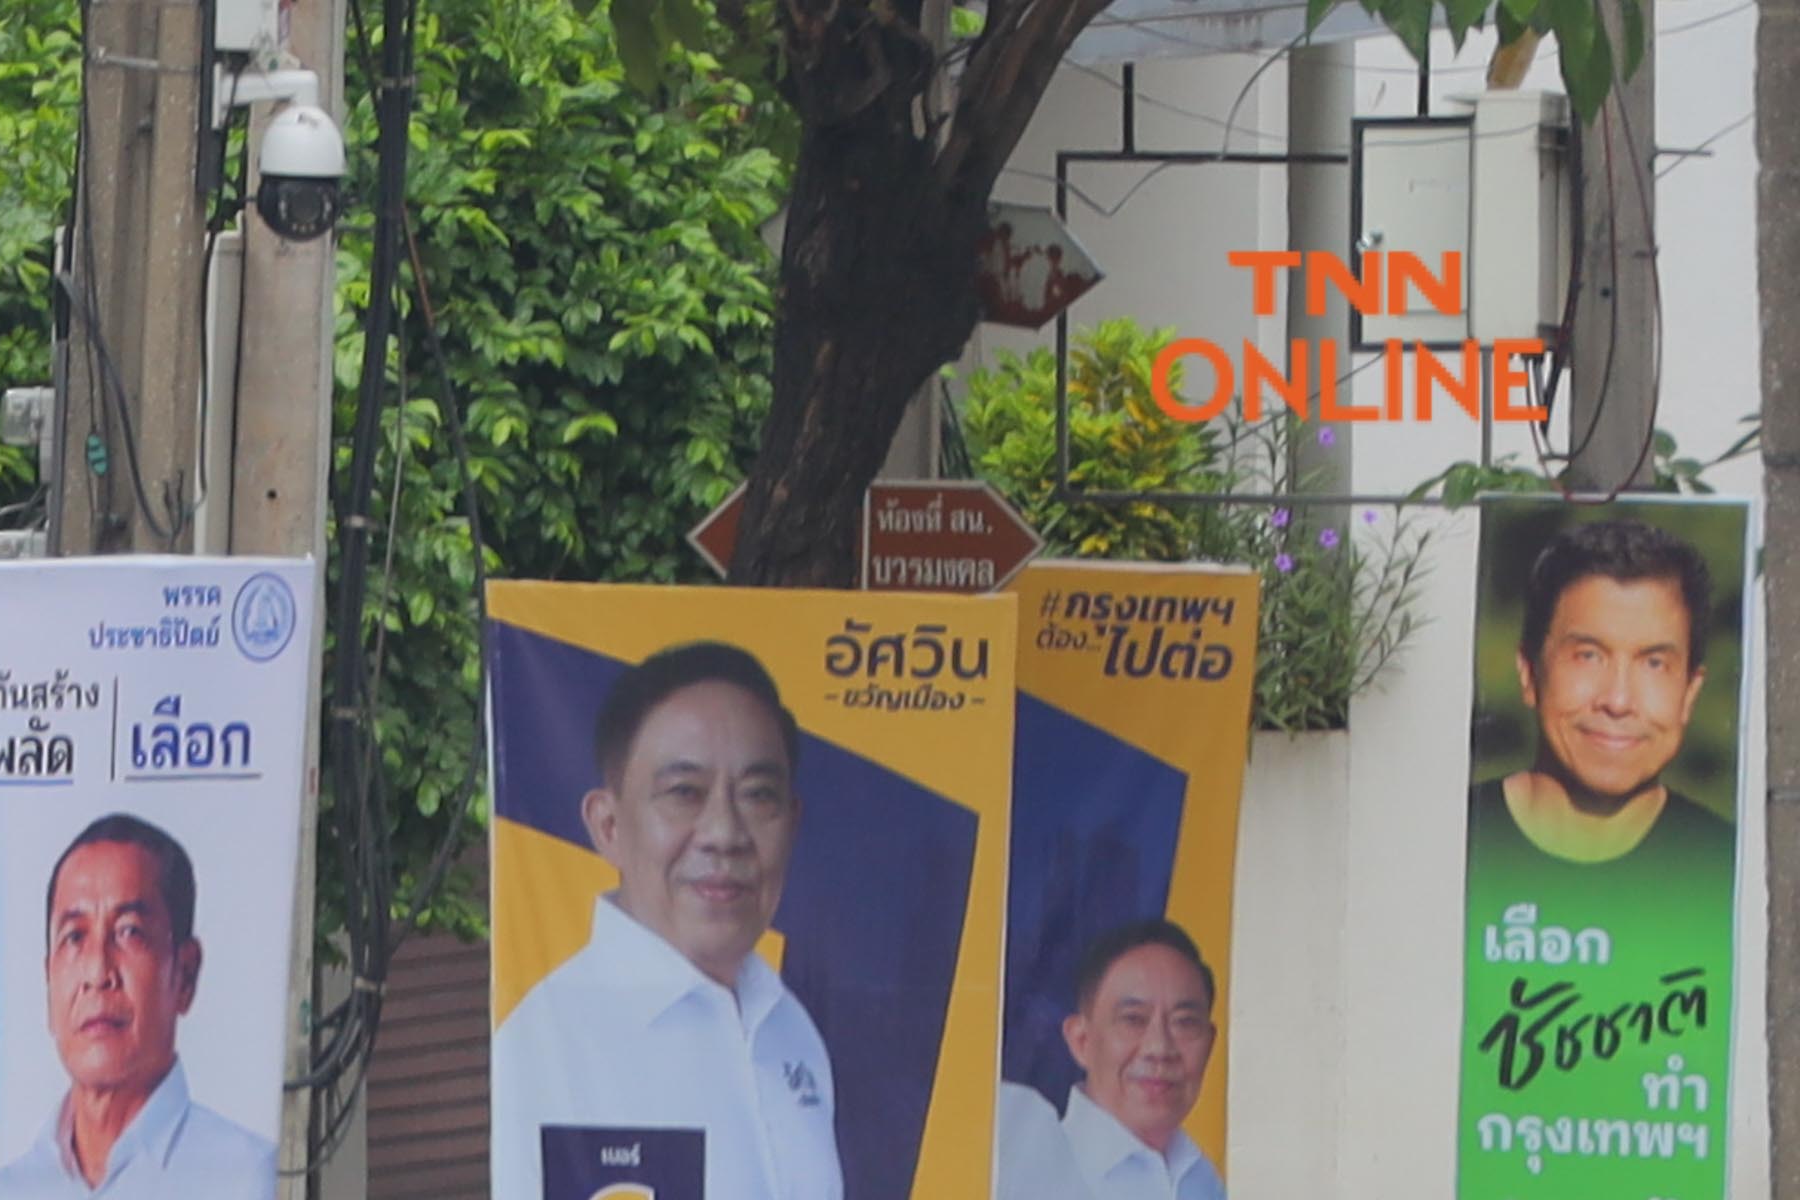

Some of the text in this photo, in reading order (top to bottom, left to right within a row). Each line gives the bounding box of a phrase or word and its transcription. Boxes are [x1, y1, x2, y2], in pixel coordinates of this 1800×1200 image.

[877, 492, 994, 535] ท้องที่ สน.
[163, 585, 221, 607] พรรค
[872, 555, 995, 587] บวรมงคล
[89, 614, 221, 649] ประชาธิปัตย์
[825, 618, 989, 681] อัศวิน
[1104, 625, 1234, 682] ไปต่อ
[131, 696, 251, 769] เลือก
[1484, 903, 1611, 964] เลือก
[1478, 968, 1707, 1091] ชัชชาติ
[1642, 1054, 1708, 1111] ทำ
[1478, 1112, 1708, 1174] กรุงเทพฯ
